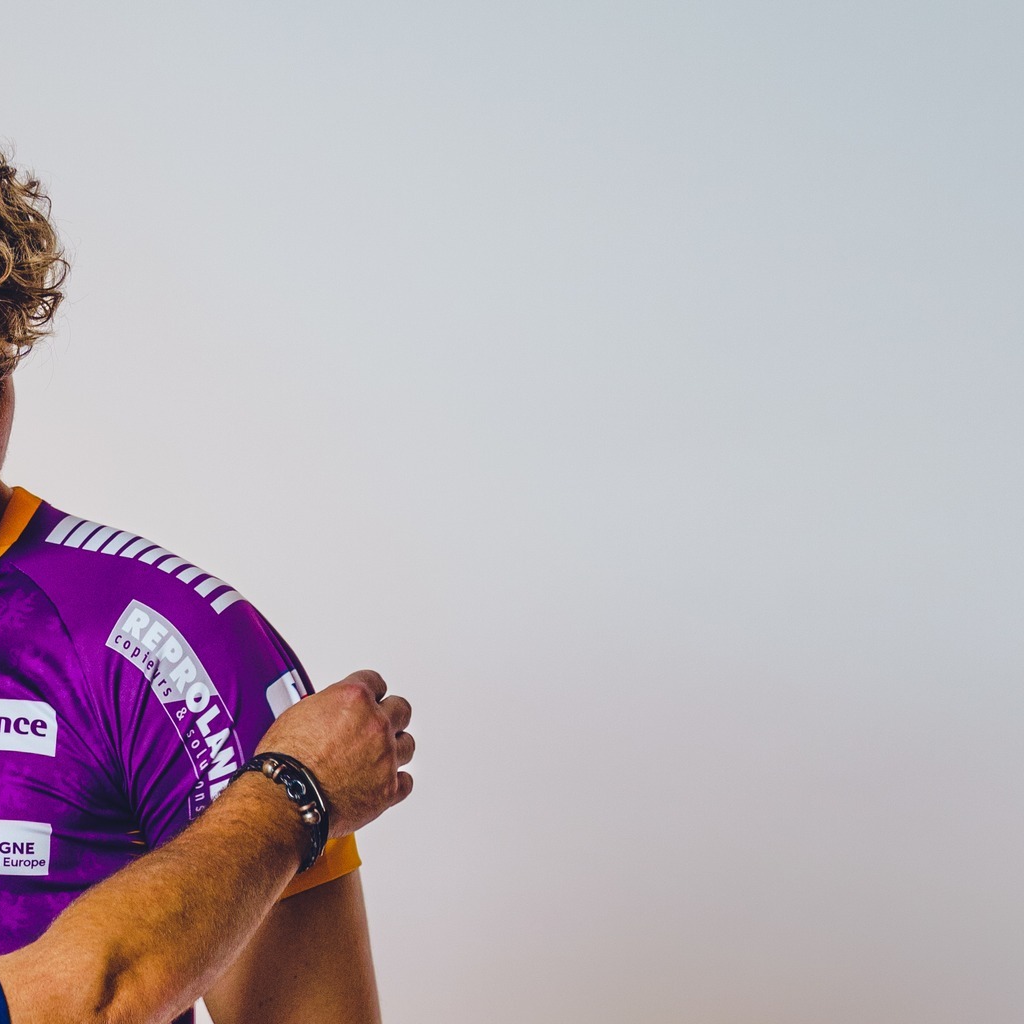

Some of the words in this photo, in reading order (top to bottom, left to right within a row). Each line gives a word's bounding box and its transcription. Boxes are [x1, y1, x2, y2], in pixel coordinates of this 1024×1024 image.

[176, 706, 187, 721] &
[186, 729, 209, 813] soluons
[2, 857, 46, 870] Europe
